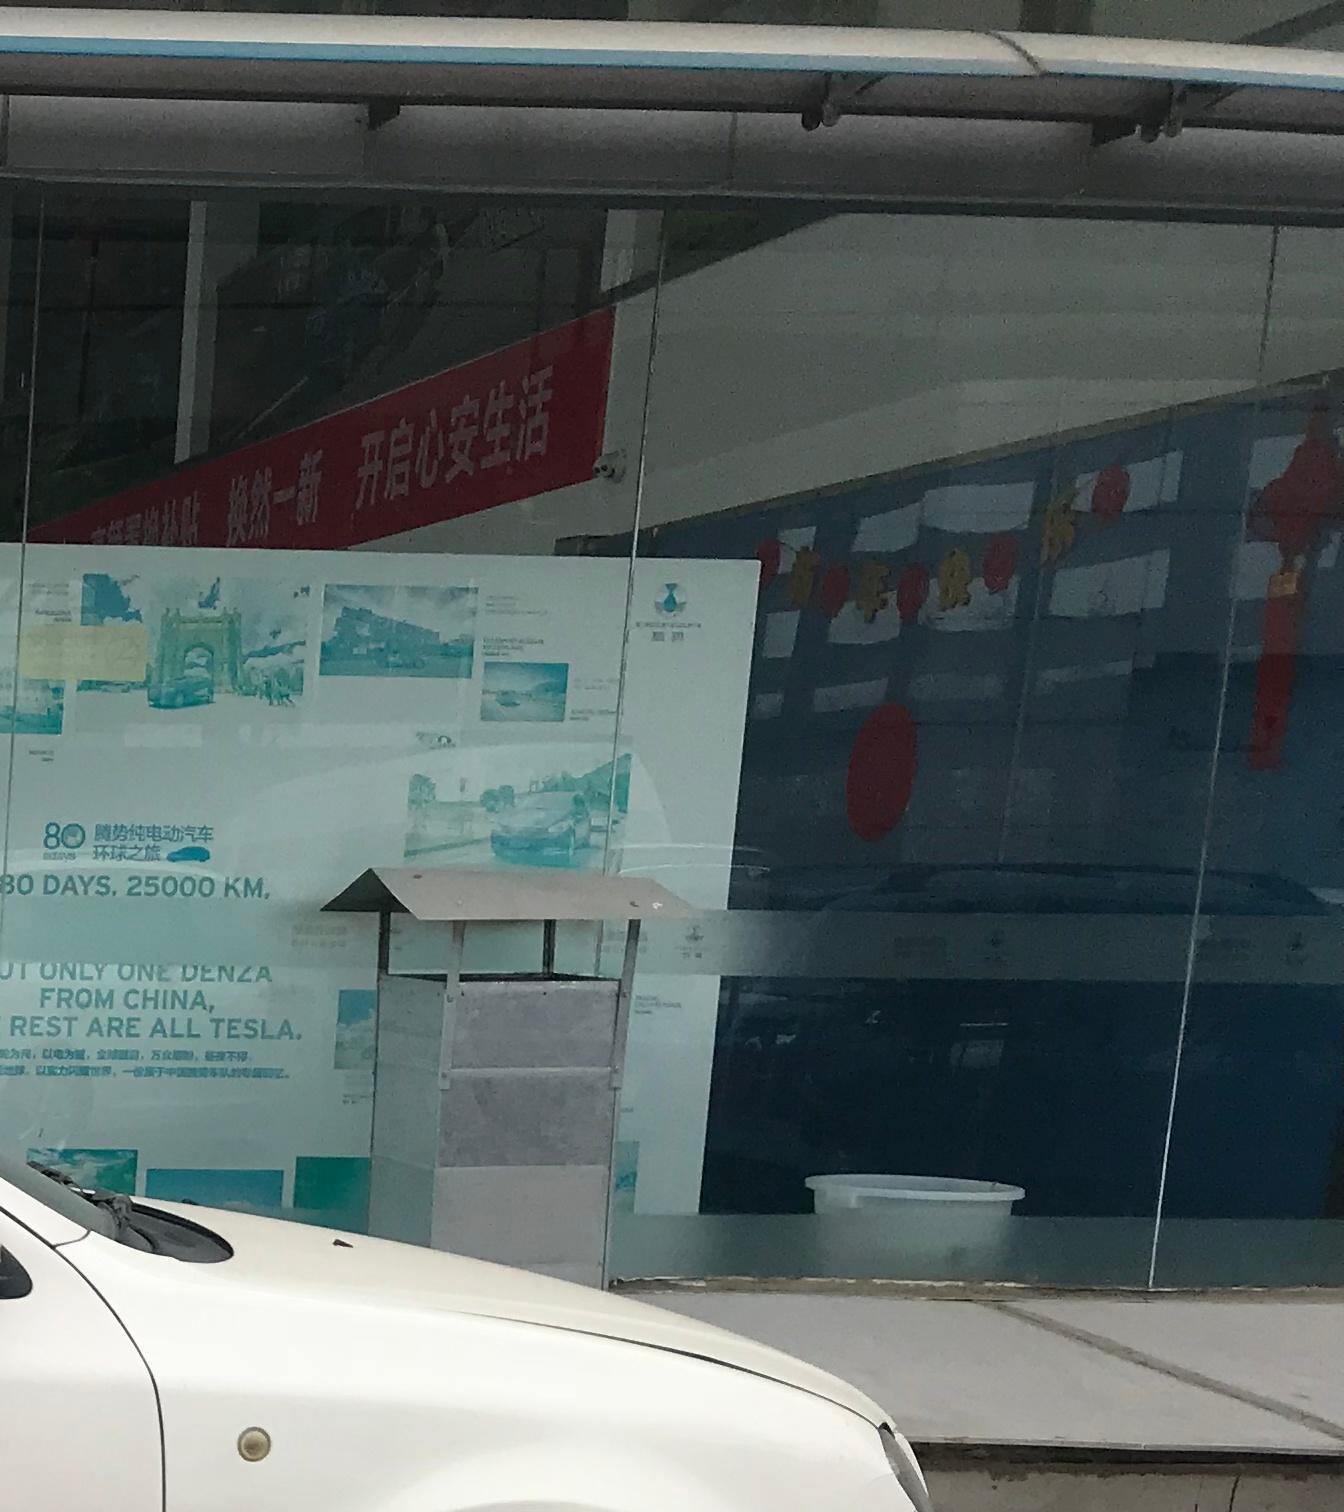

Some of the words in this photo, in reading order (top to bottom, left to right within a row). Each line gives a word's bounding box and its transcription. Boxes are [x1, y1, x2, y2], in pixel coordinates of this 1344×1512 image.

[355, 364, 554, 510] 开启心安生活
[92, 844, 161, 861] 环球之旅
[126, 875, 216, 898] 25000
[39, 961, 107, 981] ONLY
[180, 964, 273, 983] DENZA
[40, 988, 116, 1010] FROM
[123, 988, 215, 1014] CHINA,
[10, 1015, 79, 1037] REST
[85, 1017, 141, 1038] ARE
[148, 1017, 201, 1039] ALL
[208, 1018, 302, 1041] TESLA.
